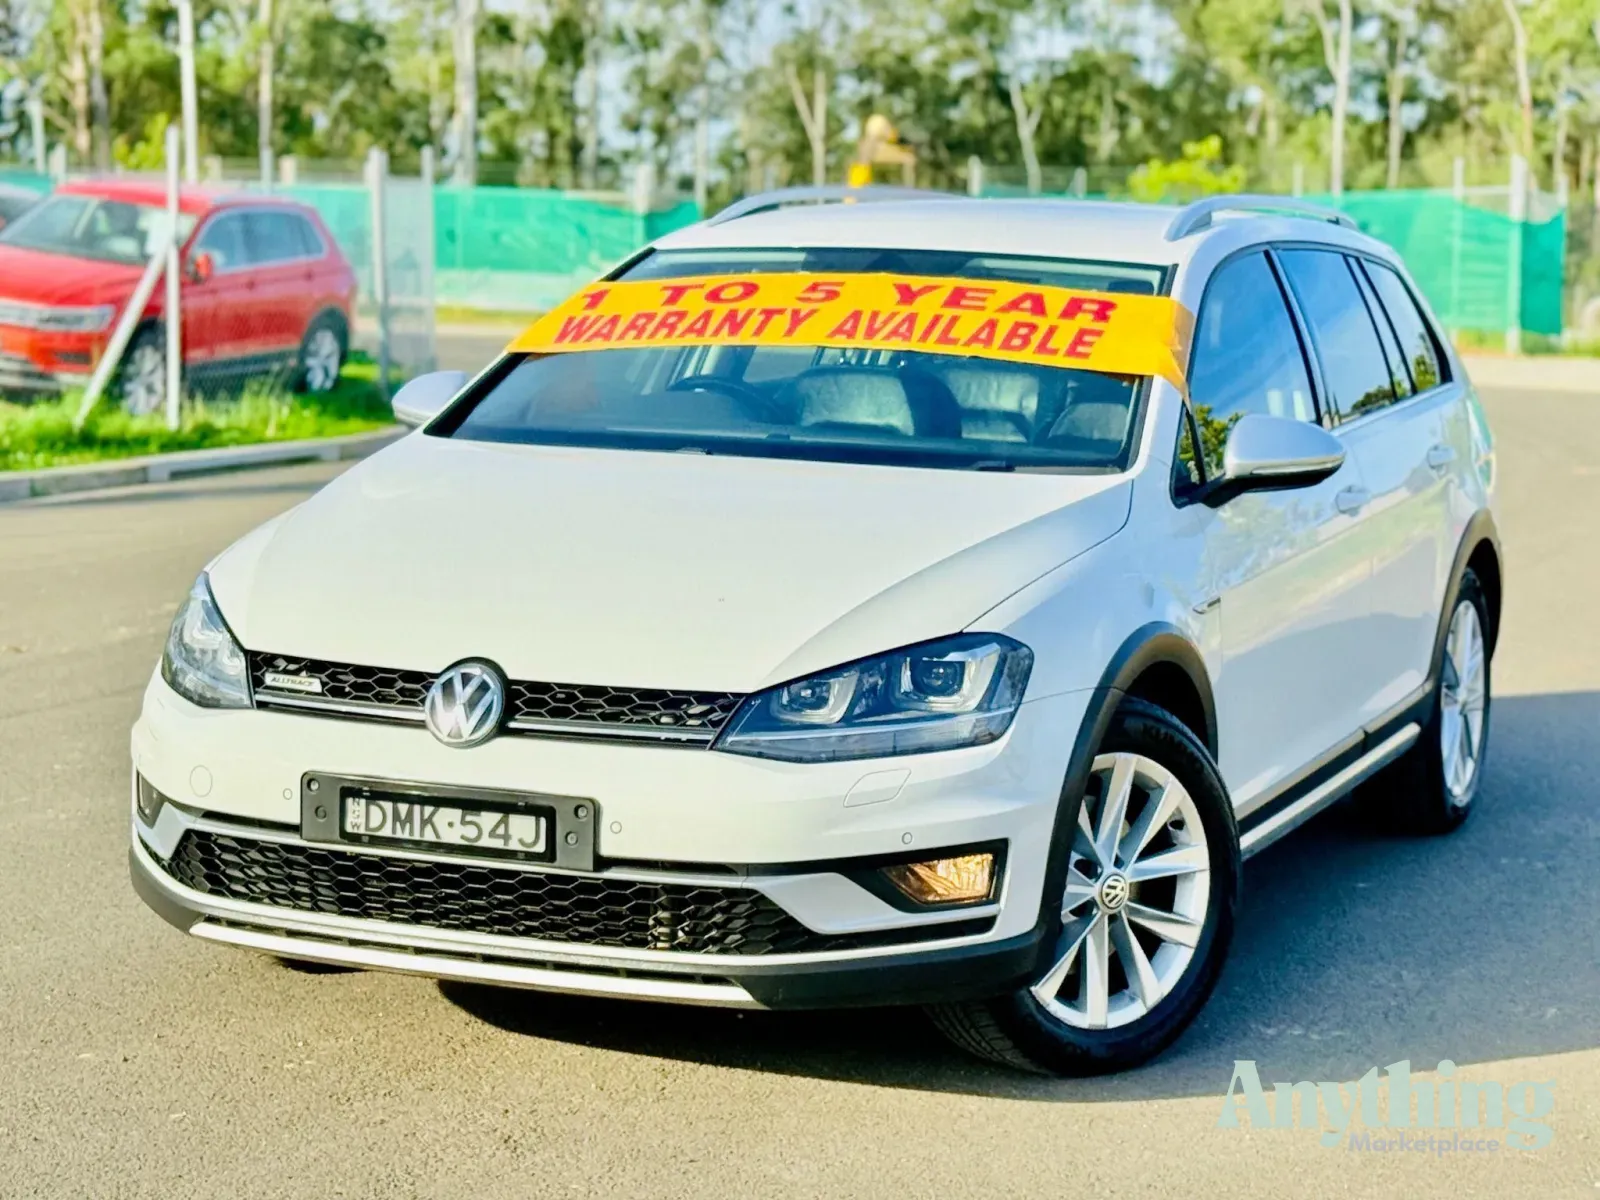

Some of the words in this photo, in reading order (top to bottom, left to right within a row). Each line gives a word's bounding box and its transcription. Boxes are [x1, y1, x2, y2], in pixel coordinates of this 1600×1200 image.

[581, 288, 612, 311] 1
[660, 281, 760, 307] TO
[795, 281, 845, 304] 5
[893, 283, 1118, 323] YEAR
[553, 308, 819, 344] WARRANTY
[825, 309, 1105, 360] AVAILABLE
